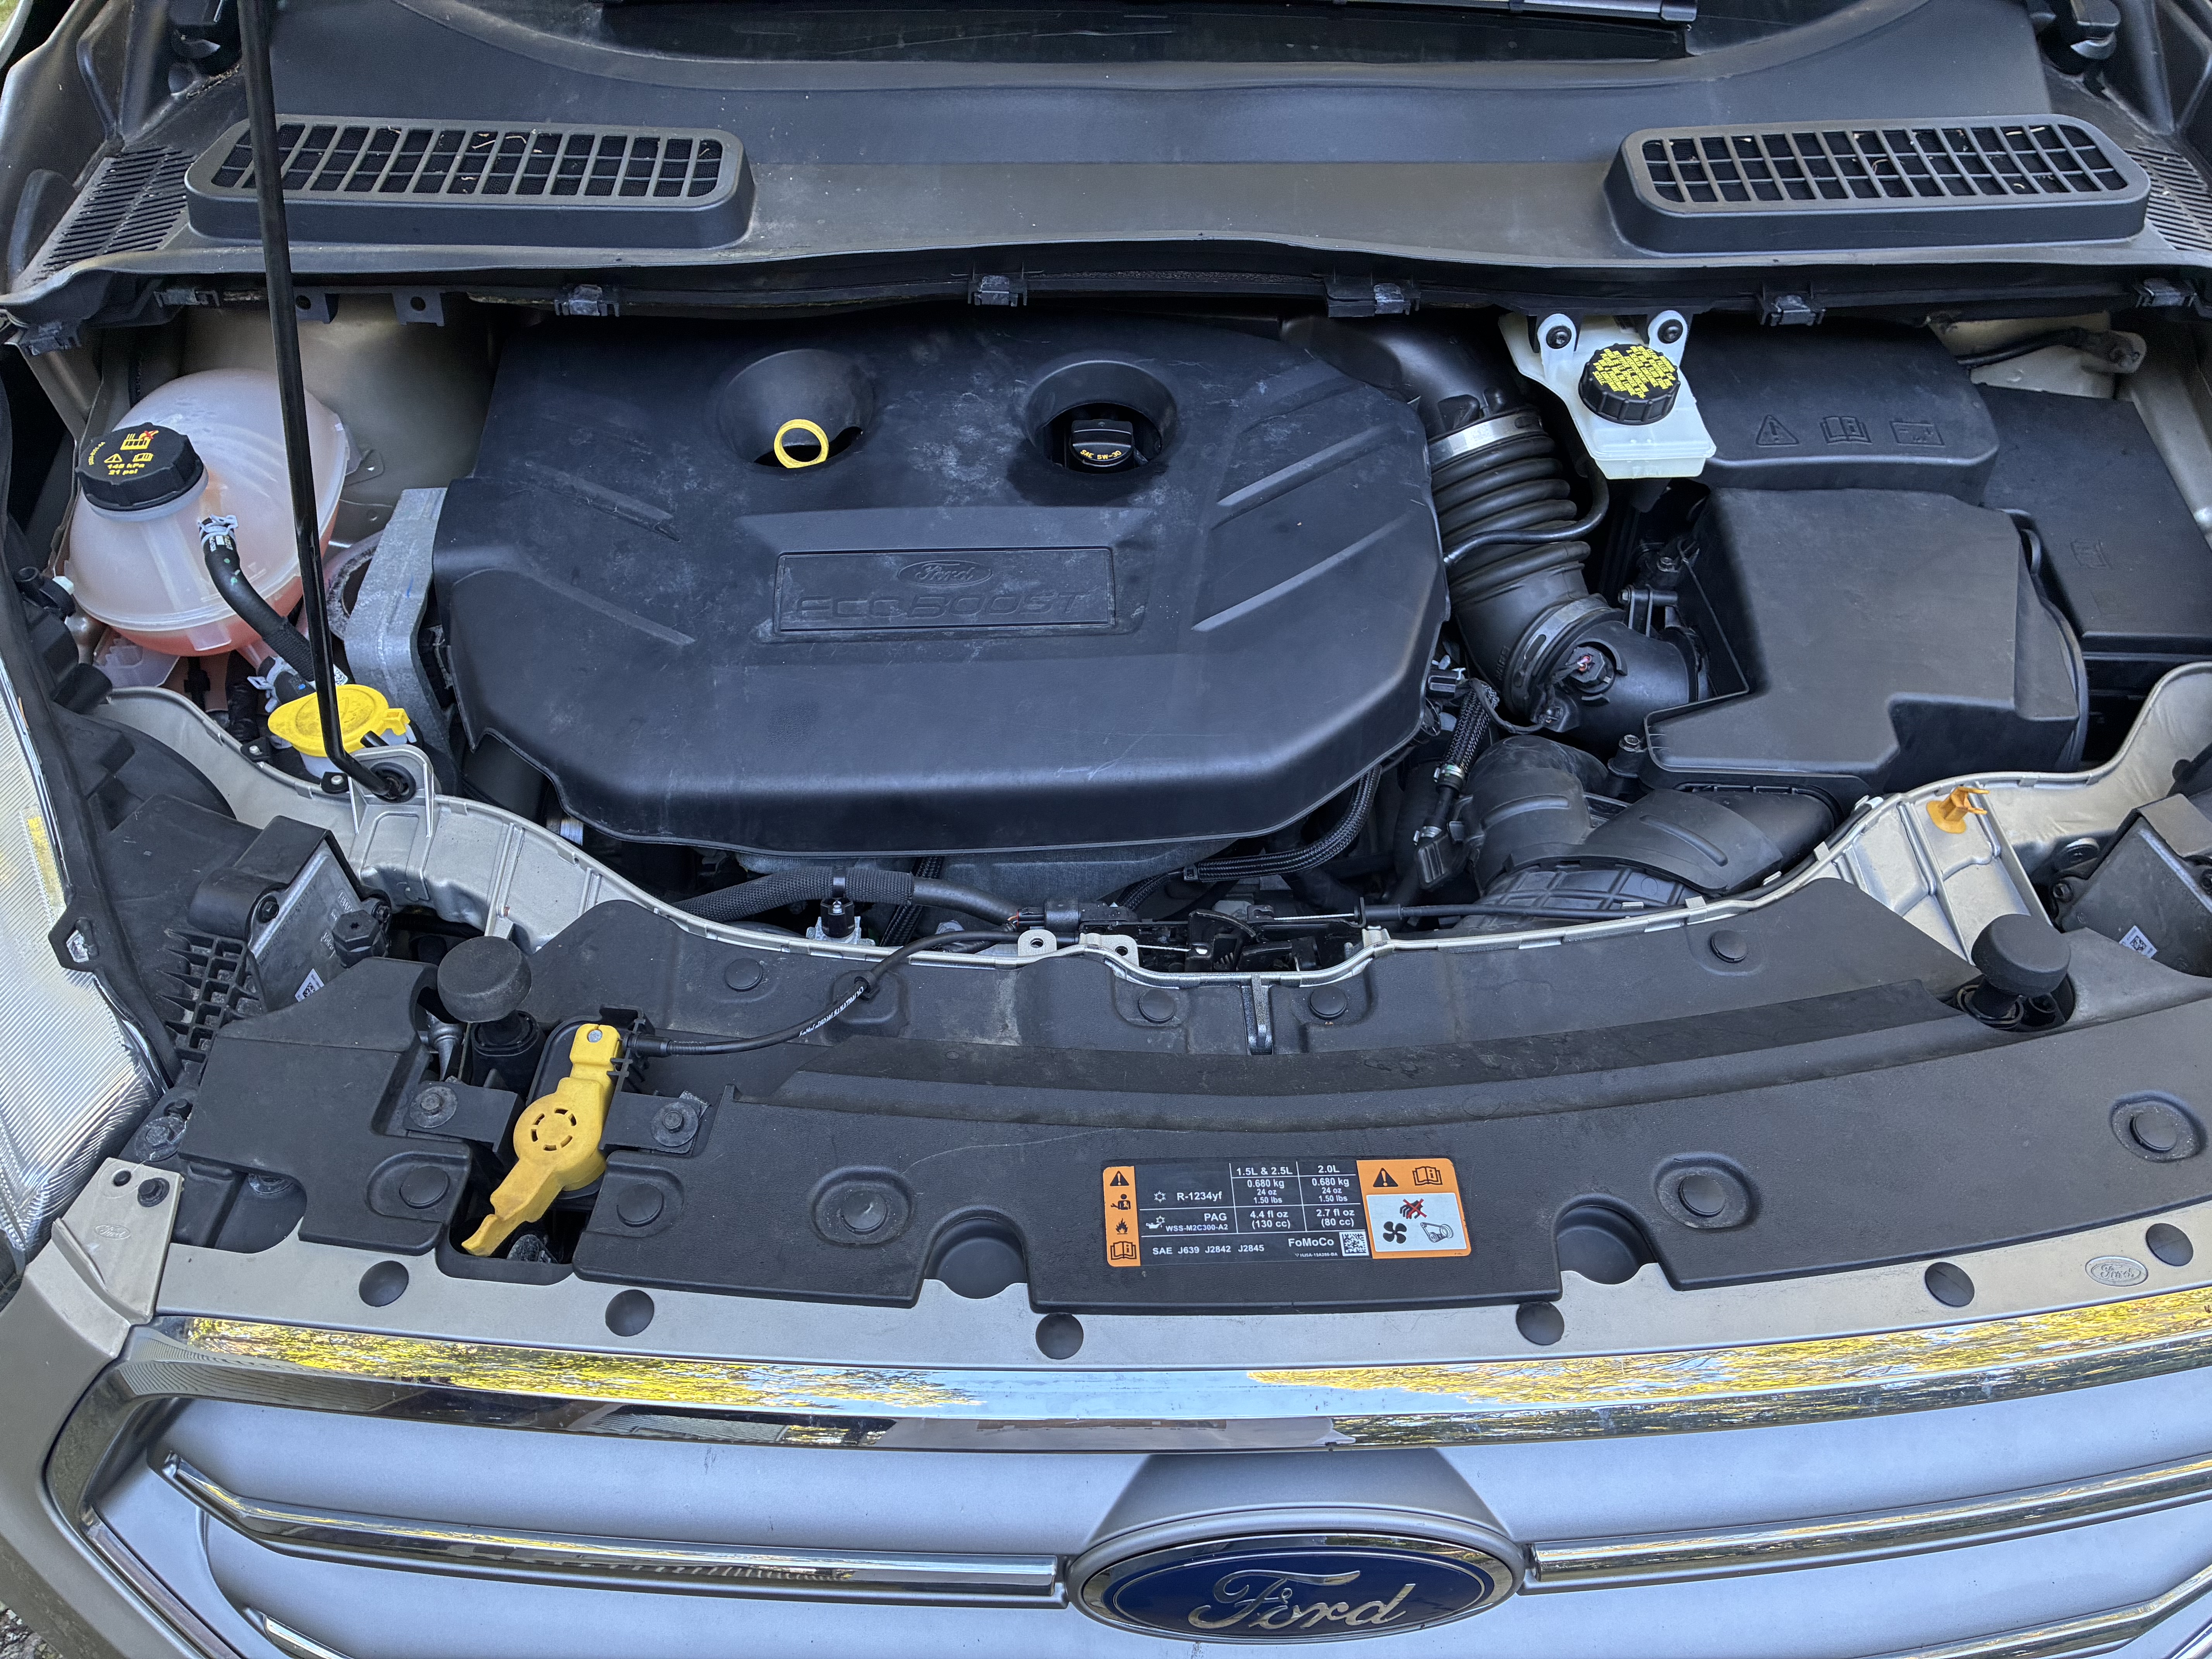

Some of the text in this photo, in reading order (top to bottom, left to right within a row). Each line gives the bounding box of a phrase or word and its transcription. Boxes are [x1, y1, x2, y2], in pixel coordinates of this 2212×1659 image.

[1080, 450, 1122, 460] SAE 5W-30
[915, 562, 974, 582] Ford
[797, 592, 1091, 619] ECOBOOST
[1237, 1167, 1258, 1176] 1.5L
[1318, 1165, 1340, 1173] 2.0L
[1247, 1179, 1285, 1189] 0.680 kg
[1312, 1178, 1349, 1187] 0.680 kg
[1177, 1191, 1222, 1202] R-1234yf
[1204, 1212, 1227, 1221] PAG
[1165, 1224, 1228, 1232] WSS-M2C300-A2
[1252, 1219, 1291, 1230] (130 cc)
[1321, 1218, 1354, 1228] (80 cc)
[1288, 1237, 1334, 1247] FoMoCo
[2100, 1264, 2134, 1278] Ford
[1187, 1569, 1416, 1629] Ford
